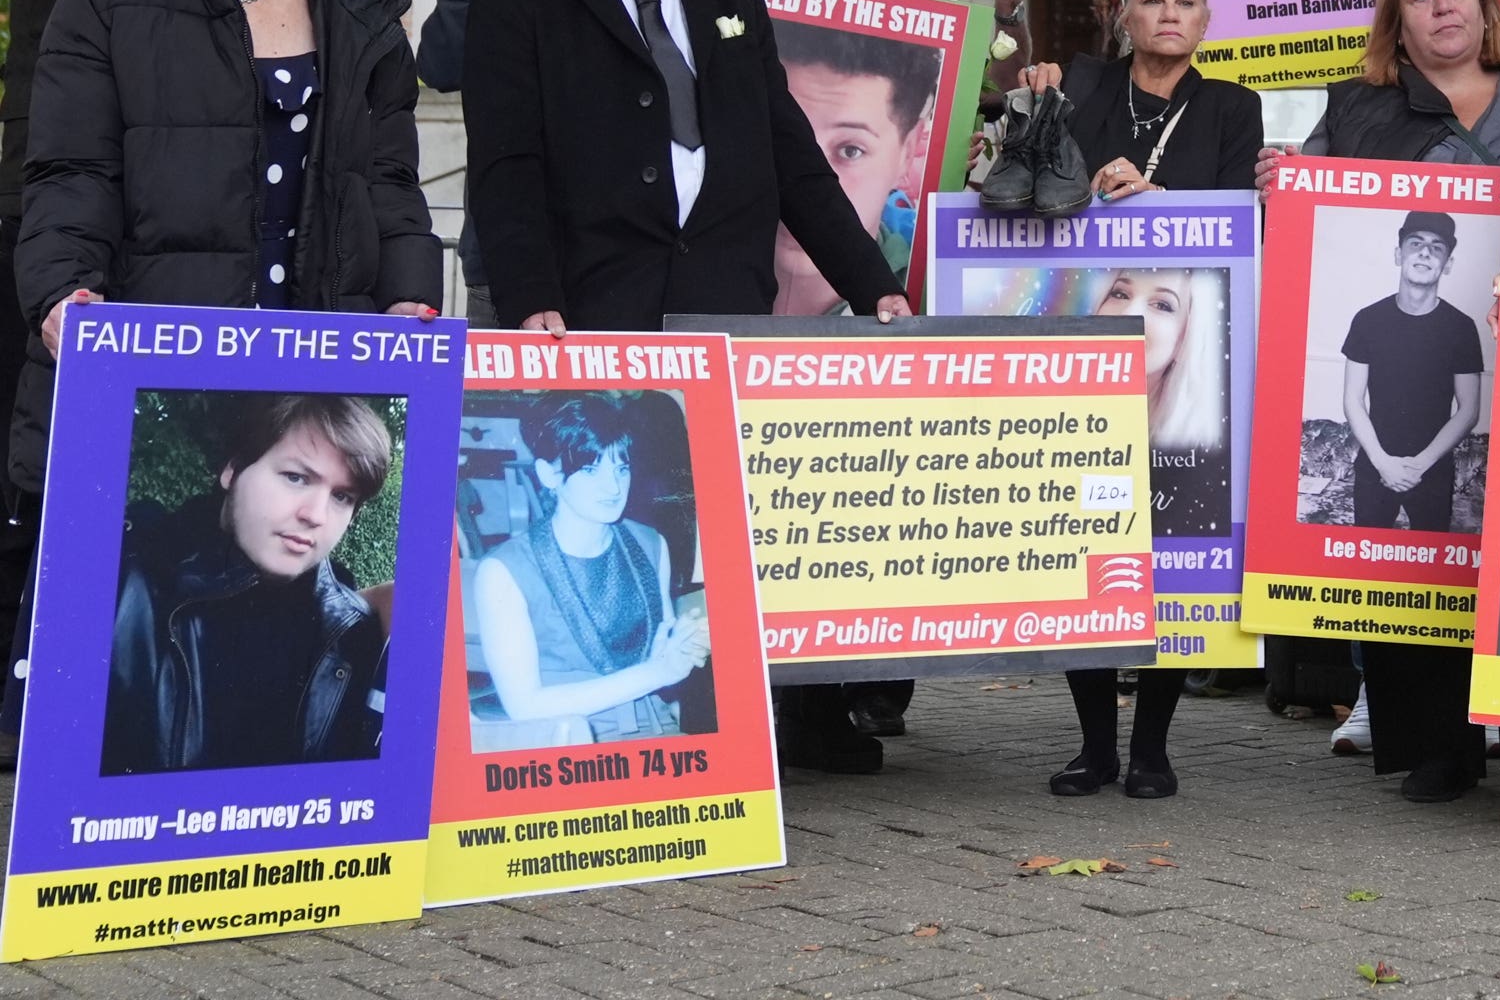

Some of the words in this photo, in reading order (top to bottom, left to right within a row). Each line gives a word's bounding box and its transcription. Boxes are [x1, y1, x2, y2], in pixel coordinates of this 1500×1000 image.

[1247, 2, 1298, 19] Darian
[958, 219, 1044, 248] FAILED
[1054, 218, 1088, 247] BY
[1095, 218, 1145, 247] THE
[1153, 217, 1232, 247] STATE
[77, 321, 202, 354] FAILED
[217, 327, 261, 356] BY
[271, 329, 339, 359] THE
[352, 332, 450, 362] STATE
[746, 355, 914, 386] DESERVE
[923, 354, 995, 384] THE
[1004, 353, 1132, 383] TRUTH!
[761, 417, 912, 445] government
[921, 416, 991, 436] wants
[998, 412, 1078, 440] people
[1087, 414, 1107, 433] to
[748, 451, 803, 480] they
[810, 449, 909, 477] actually
[916, 454, 968, 470] care
[976, 447, 1044, 469] about
[1051, 444, 1132, 467] mental
[1152, 450, 1196, 468] lived
[771, 486, 826, 514] they
[833, 484, 894, 507] need
[902, 486, 925, 506] to
[933, 483, 999, 505] listen
[1009, 484, 1030, 503] to
[1039, 480, 1075, 502] the
[1088, 485, 1128, 501] 120+
[786, 522, 808, 544] in
[817, 522, 891, 543] Essex
[899, 518, 948, 540] who
[956, 517, 1012, 539] have
[1021, 512, 1120, 536] suffered
[1125, 512, 1136, 535] /
[809, 561, 874, 582] ones,
[884, 555, 925, 576] not
[932, 552, 1009, 580] ignore
[1211, 548, 1232, 569] 21
[1325, 538, 1355, 558] Lee
[1360, 540, 1437, 563] Spencer
[1444, 545, 1467, 565] 20
[815, 617, 903, 645] Public
[912, 613, 1007, 646] Inquiry
[1014, 606, 1145, 642] @eputnhs
[486, 760, 552, 792] Doris
[558, 753, 629, 785] Smith
[639, 749, 666, 777] 74
[670, 750, 707, 777] yrs
[221, 805, 300, 831] Harvey
[303, 799, 331, 824] 25
[340, 800, 374, 824] yrs
[95, 903, 341, 943] #matthewscampaign
